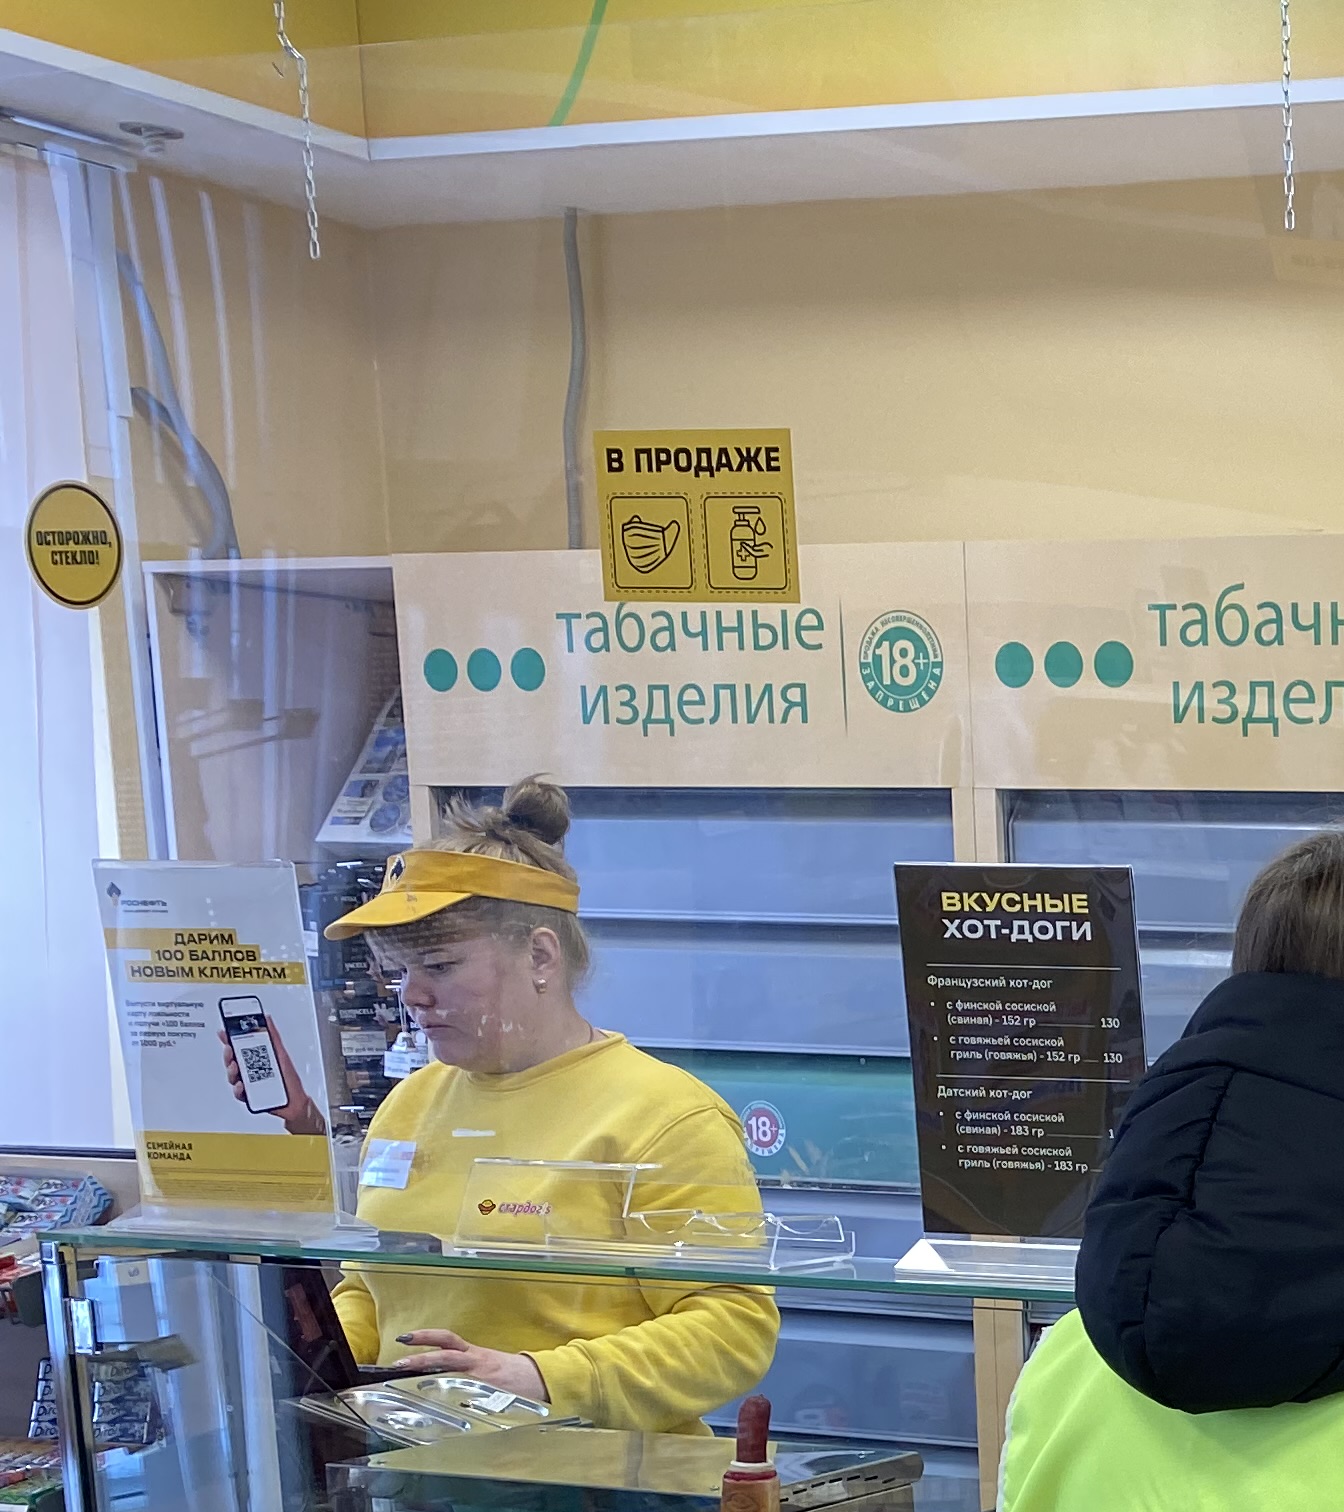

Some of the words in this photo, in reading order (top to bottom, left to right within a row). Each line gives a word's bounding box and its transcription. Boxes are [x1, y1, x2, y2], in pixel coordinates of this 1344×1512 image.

[606, 448, 624, 474] В
[635, 447, 782, 478] ПРОДАЖЕ
[36, 530, 113, 551] ОСТОРОЖНО,
[51, 547, 100, 566] СТЕКЛО!
[556, 604, 824, 656] табачные
[875, 640, 928, 686] 18+
[861, 667, 941, 711] ЗАПРЕЩЕНА
[579, 680, 809, 737] изделия
[941, 892, 1089, 914] ВКУСНЫЕ
[942, 919, 1092, 942] ХОТ-ДОГИ
[174, 933, 234, 946] ДАРИМ
[155, 950, 184, 961] 100
[189, 950, 257, 962] БАЛЛОВ
[130, 966, 194, 978] НОВЫМ
[198, 966, 286, 980] КЛИЕНТАМ
[927, 975, 1006, 989] Французский
[1009, 977, 1053, 989] хот-дог
[956, 1001, 1002, 1012] финской
[1005, 1001, 1056, 1012] сосиской
[948, 1015, 992, 1027] (свиная)
[1002, 1016, 1021, 1026] 152
[1024, 1017, 1036, 1028] гр
[1100, 1018, 1120, 1029] 130
[951, 1049, 982, 1061] гриль
[985, 1050, 1037, 1062] (говяжья)
[938, 1086, 986, 1099] Датский
[989, 1088, 1032, 1100] хот-дог
[147, 1141, 193, 1151] СЕМЕЙНАЯ
[148, 1152, 192, 1161] КОМАНДА
